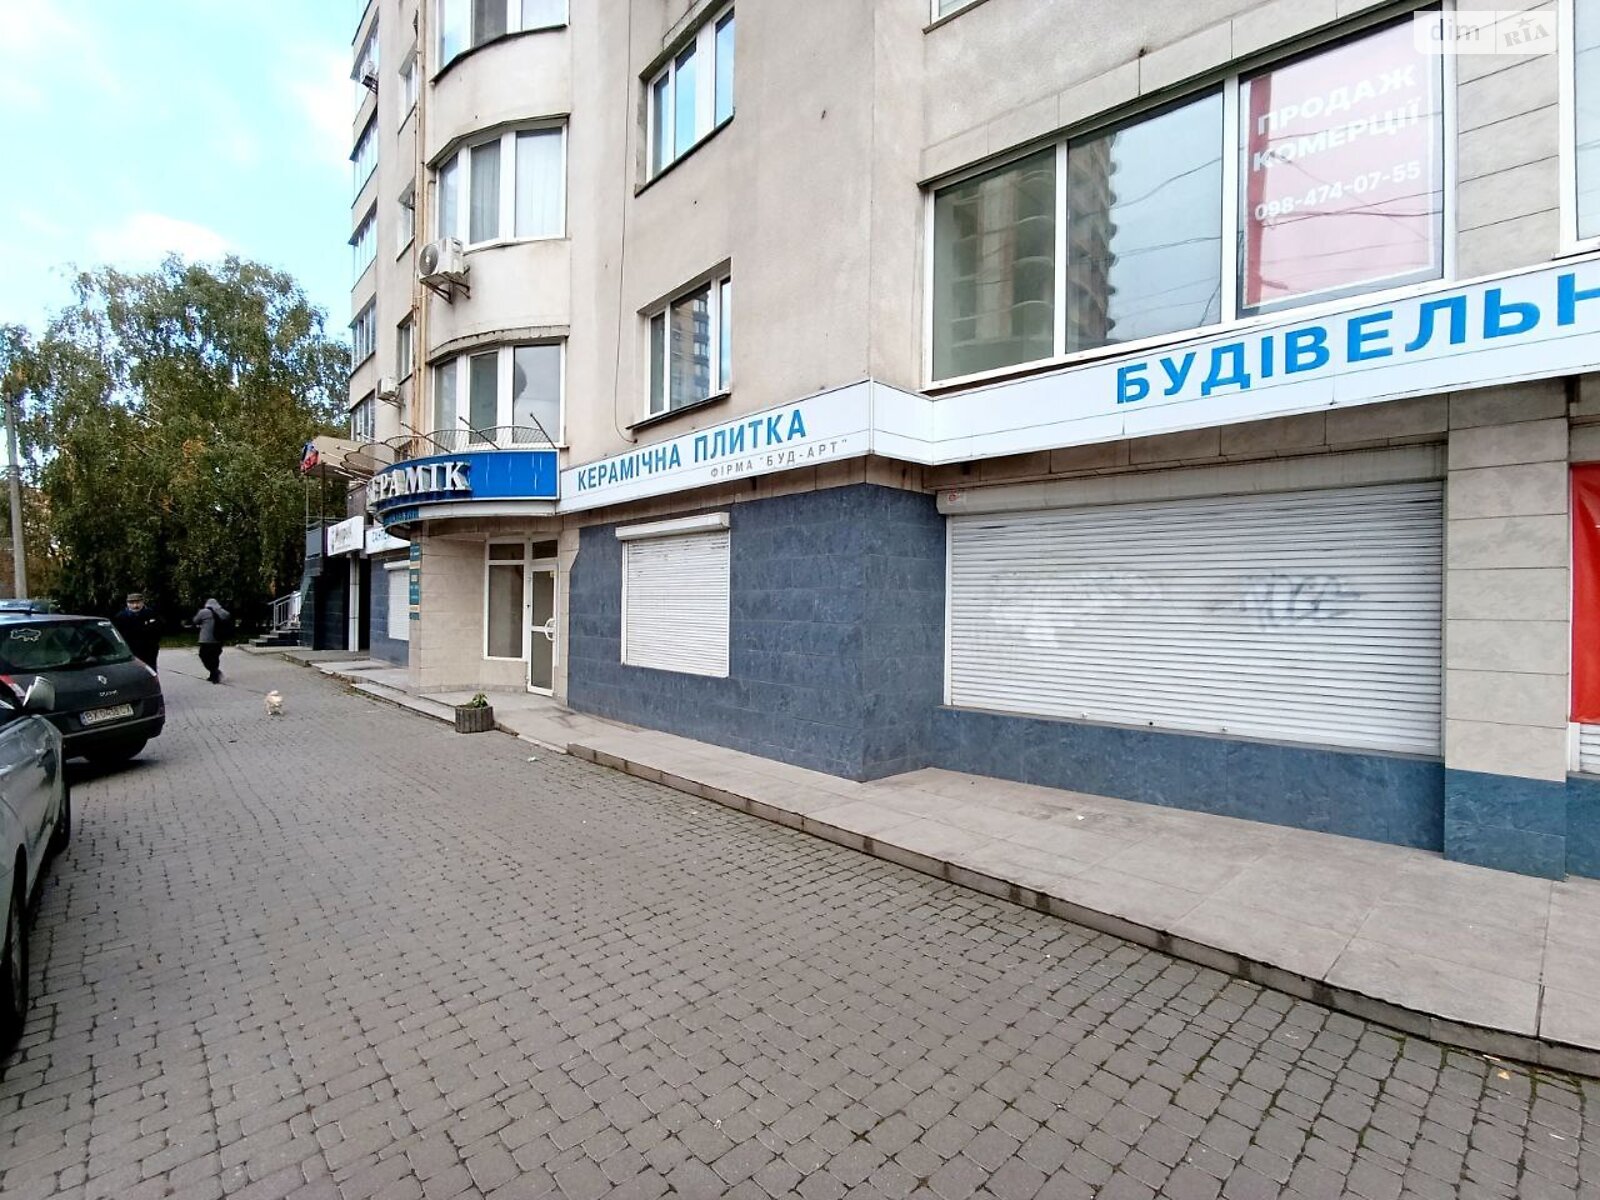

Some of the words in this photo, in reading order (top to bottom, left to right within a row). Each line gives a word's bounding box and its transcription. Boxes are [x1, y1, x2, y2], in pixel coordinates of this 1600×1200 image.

[1253, 96, 1421, 172] КОМЕРЦІЇ
[1257, 64, 1417, 136] ПРОДАЖ
[1254, 160, 1421, 222] 098-474-07-55
[1116, 272, 1600, 404] БУДІВЕЛЬН
[577, 443, 682, 492] КЕРАМІЧНА
[694, 409, 807, 464] ПЛИТКА
[710, 462, 754, 479] ФІРМА
